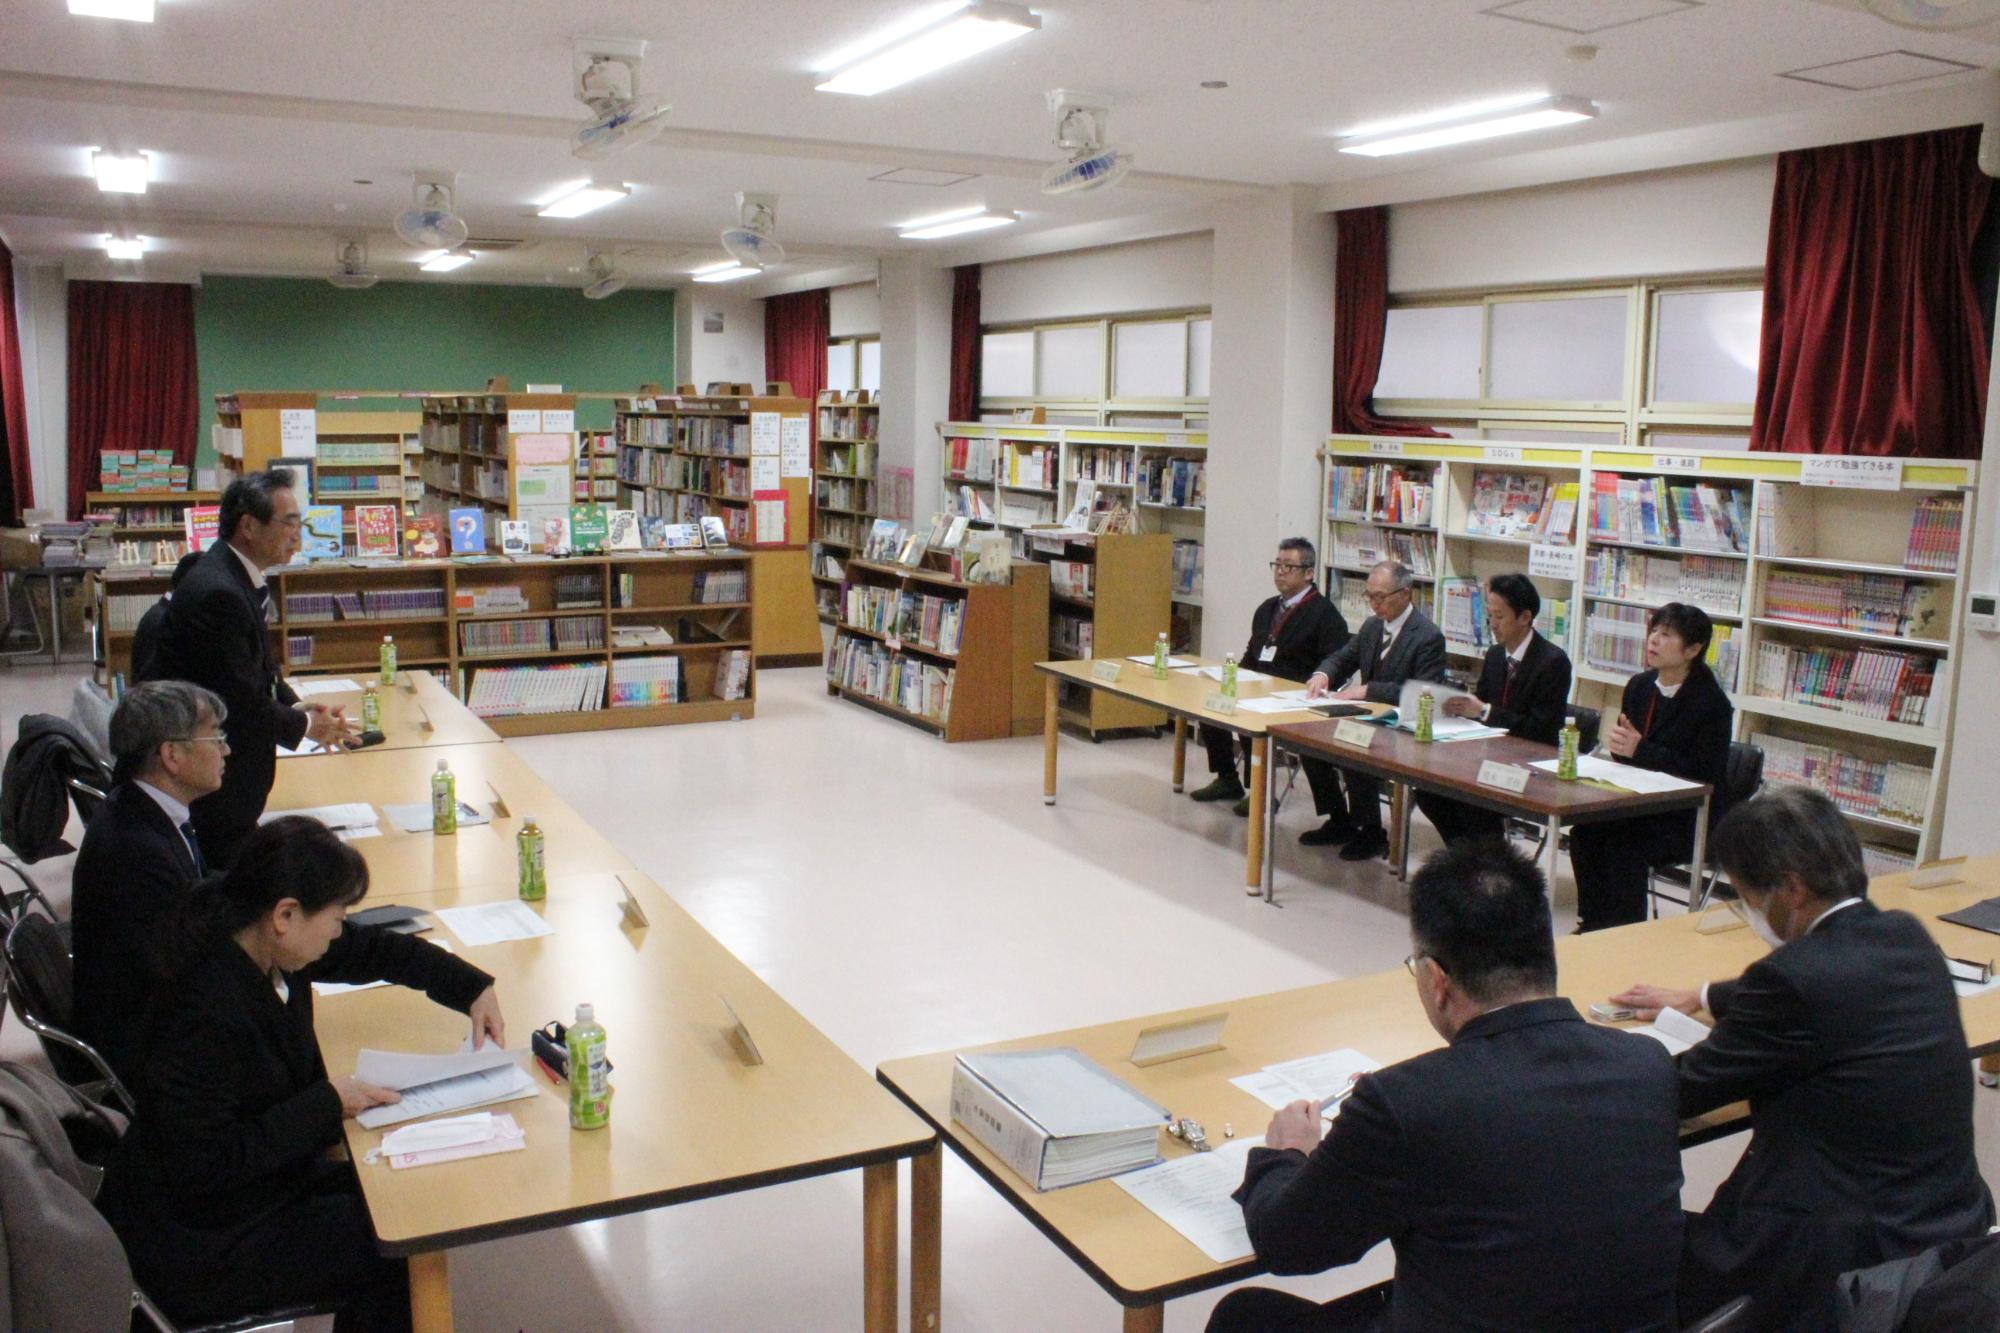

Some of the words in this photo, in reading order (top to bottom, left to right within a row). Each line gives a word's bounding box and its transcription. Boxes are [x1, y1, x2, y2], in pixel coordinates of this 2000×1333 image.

[1491, 449, 1515, 458] SDGs
[1809, 459, 1894, 471] マンガで勉強できる本
